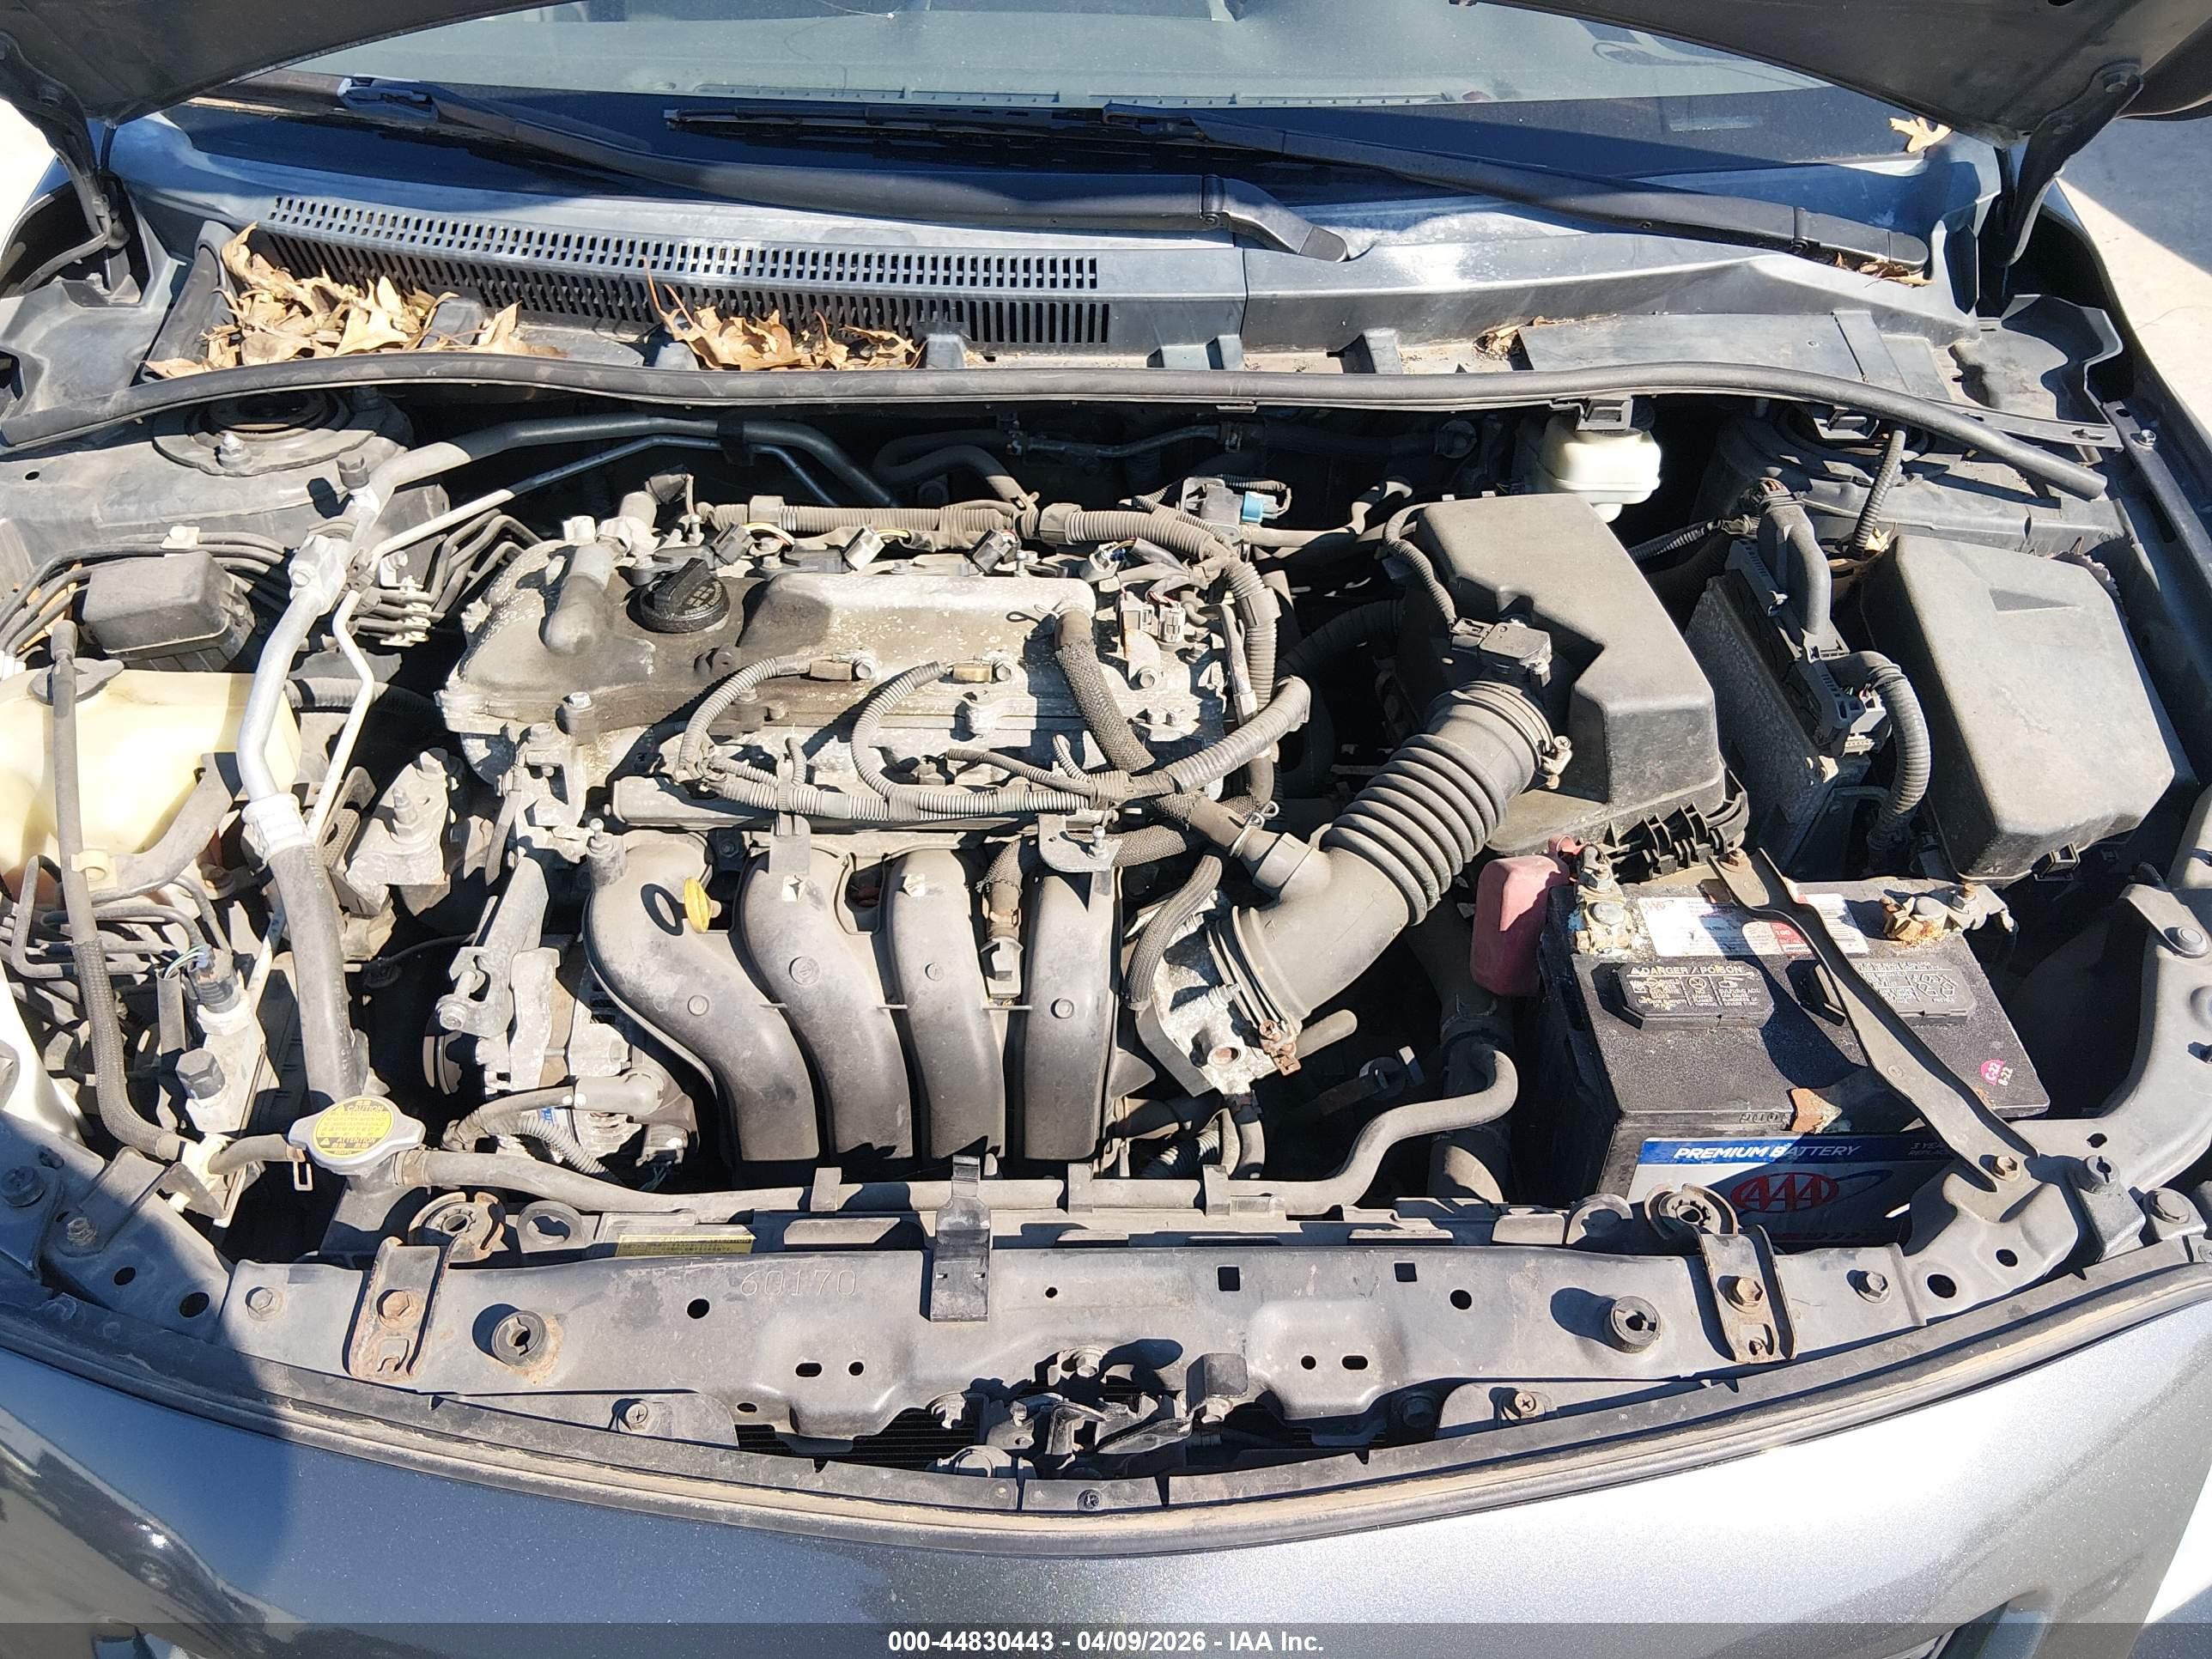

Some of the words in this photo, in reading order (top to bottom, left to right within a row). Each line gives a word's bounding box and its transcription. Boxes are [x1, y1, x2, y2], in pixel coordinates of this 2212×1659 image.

[1641, 966, 1687, 975] DANGER
[1700, 965, 1743, 974] POISON
[1998, 1066, 2013, 1085] 8-22
[1674, 1146, 1770, 1159] PREMIUM
[1769, 1145, 1862, 1158] BATTERY
[1732, 1172, 1838, 1213] AAA
[740, 1269, 857, 1297] 60170
